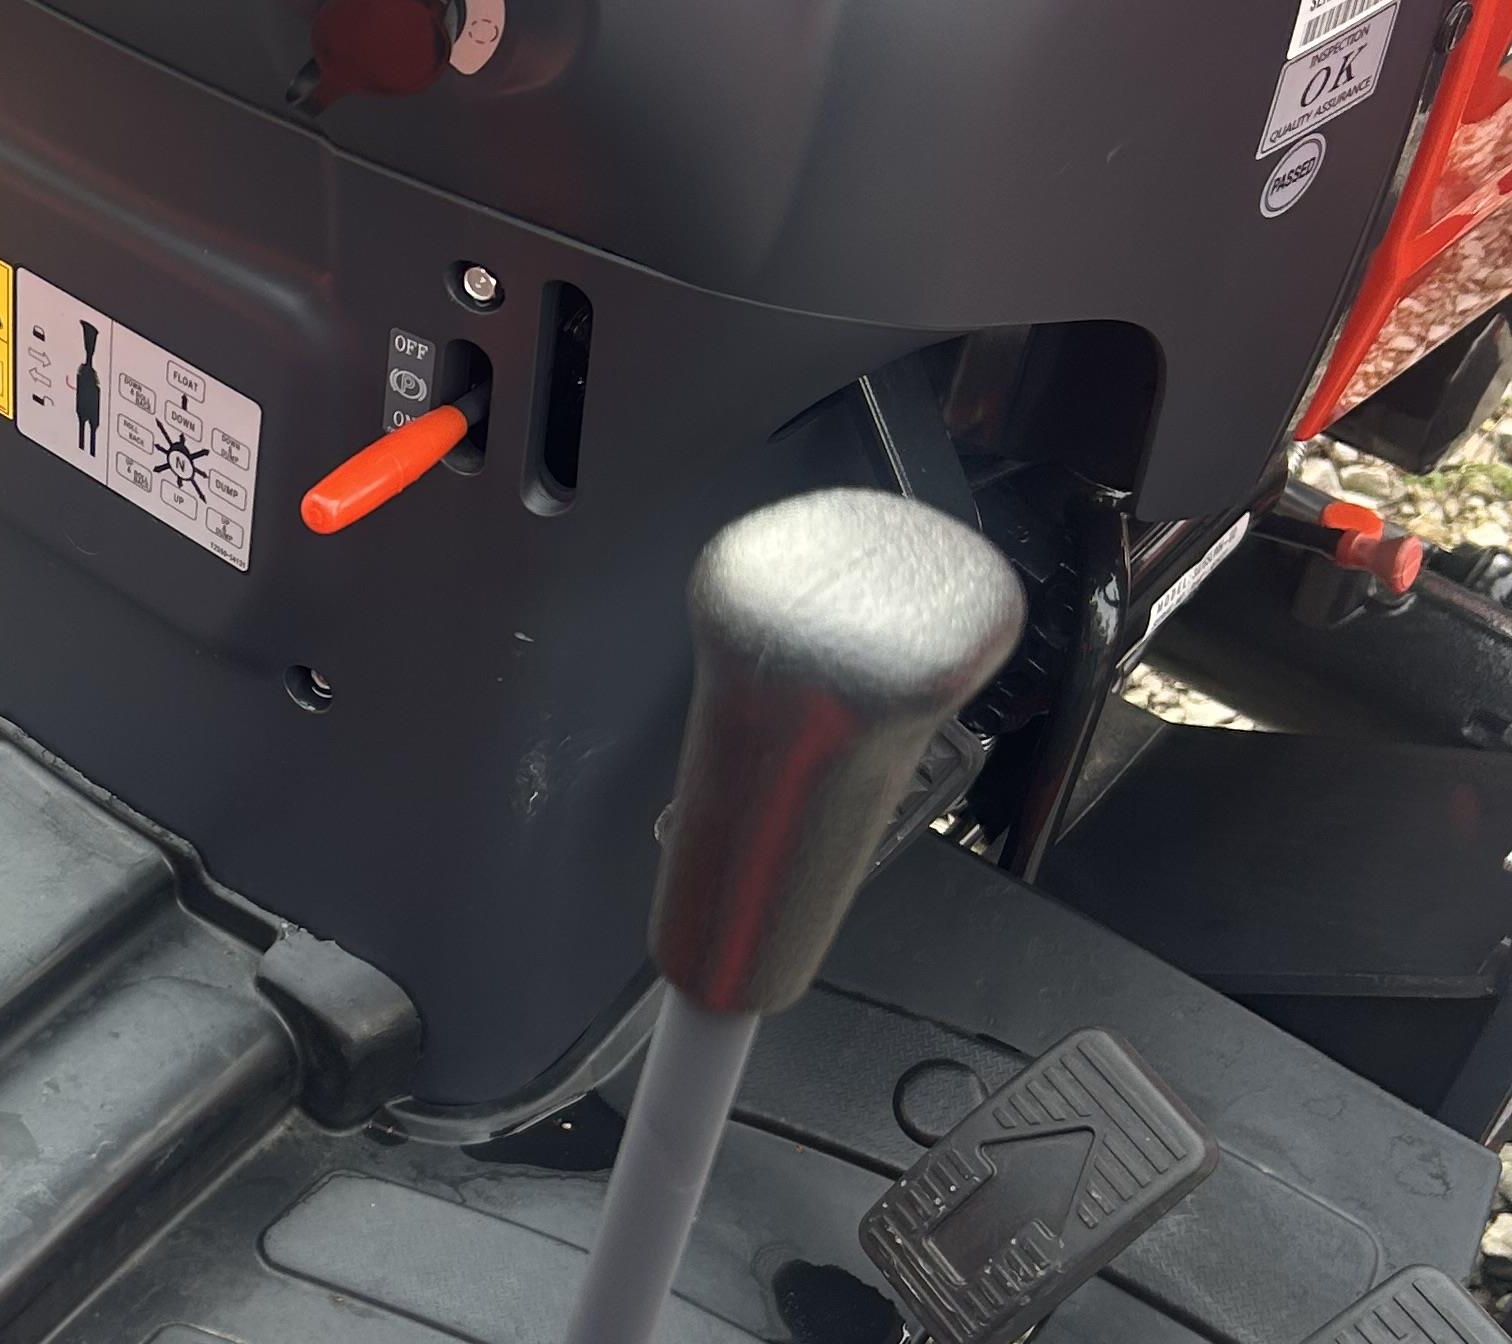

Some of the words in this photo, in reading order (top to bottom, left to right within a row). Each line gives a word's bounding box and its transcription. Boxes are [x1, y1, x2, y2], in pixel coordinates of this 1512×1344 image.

[1309, 23, 1372, 68] INSPECTION
[1300, 43, 1368, 107] OK
[1269, 109, 1313, 143] QUALITY
[1314, 75, 1372, 117] ASSURANCE
[1270, 157, 1316, 195] PASSED
[394, 335, 428, 360] OFF
[173, 370, 198, 393] FLOAT
[171, 411, 195, 432] DOWN
[175, 456, 186, 472] N
[173, 494, 185, 505] UP
[215, 480, 239, 499] DUMP
